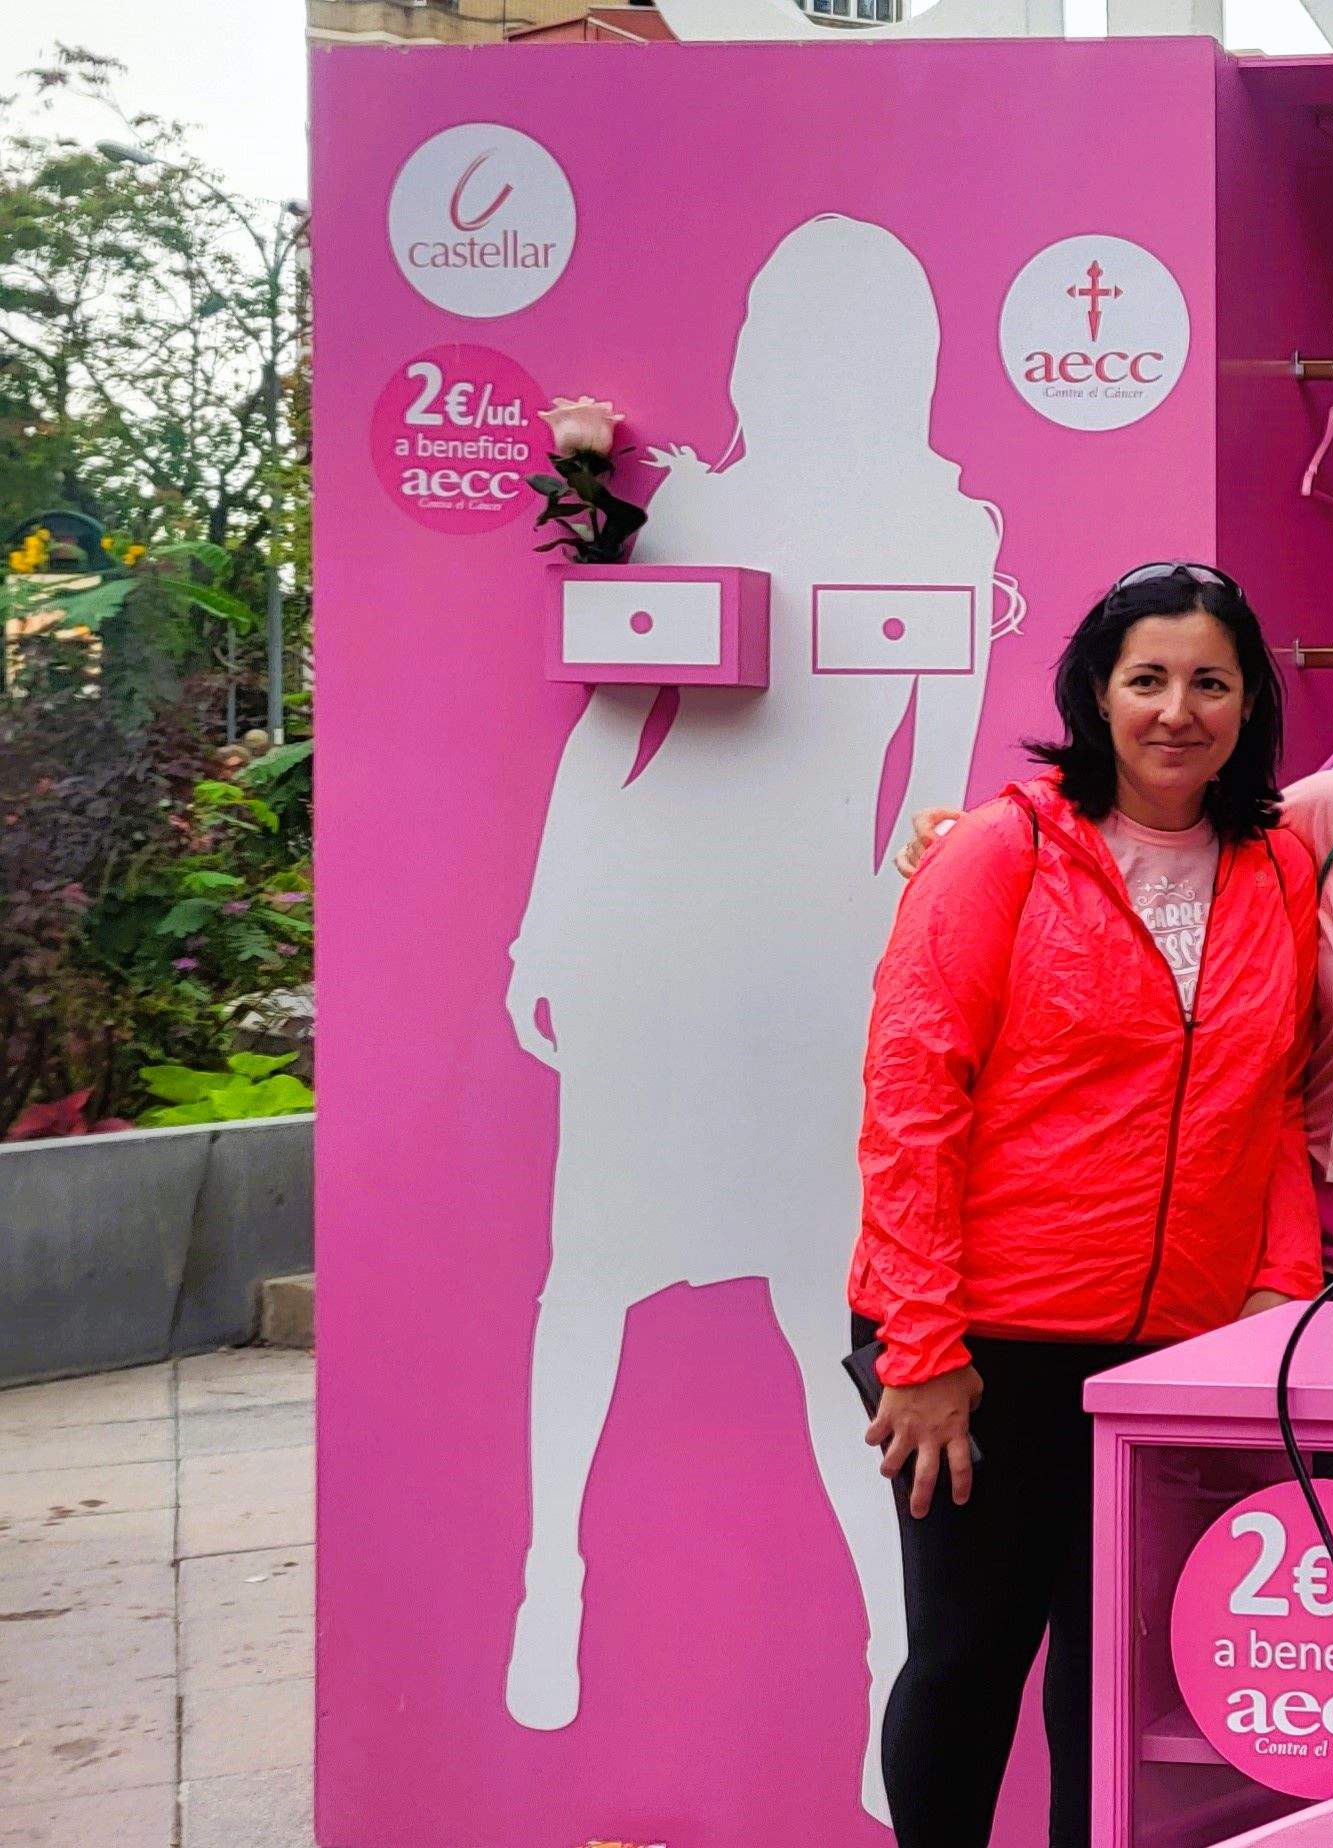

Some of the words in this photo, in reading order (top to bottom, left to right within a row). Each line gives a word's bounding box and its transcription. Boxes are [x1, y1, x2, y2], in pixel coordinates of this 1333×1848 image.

[408, 230, 556, 269] castellar
[1024, 351, 1164, 384] aecc
[405, 361, 529, 429] 2€/ud.
[1044, 386, 1084, 399] Contra
[395, 438, 409, 457] a
[416, 432, 529, 461] beneficio
[402, 468, 520, 499] aecc
[1213, 1639, 1235, 1667] a
[1254, 1738, 1307, 1757] Contra
[1314, 1740, 1328, 1758] el
